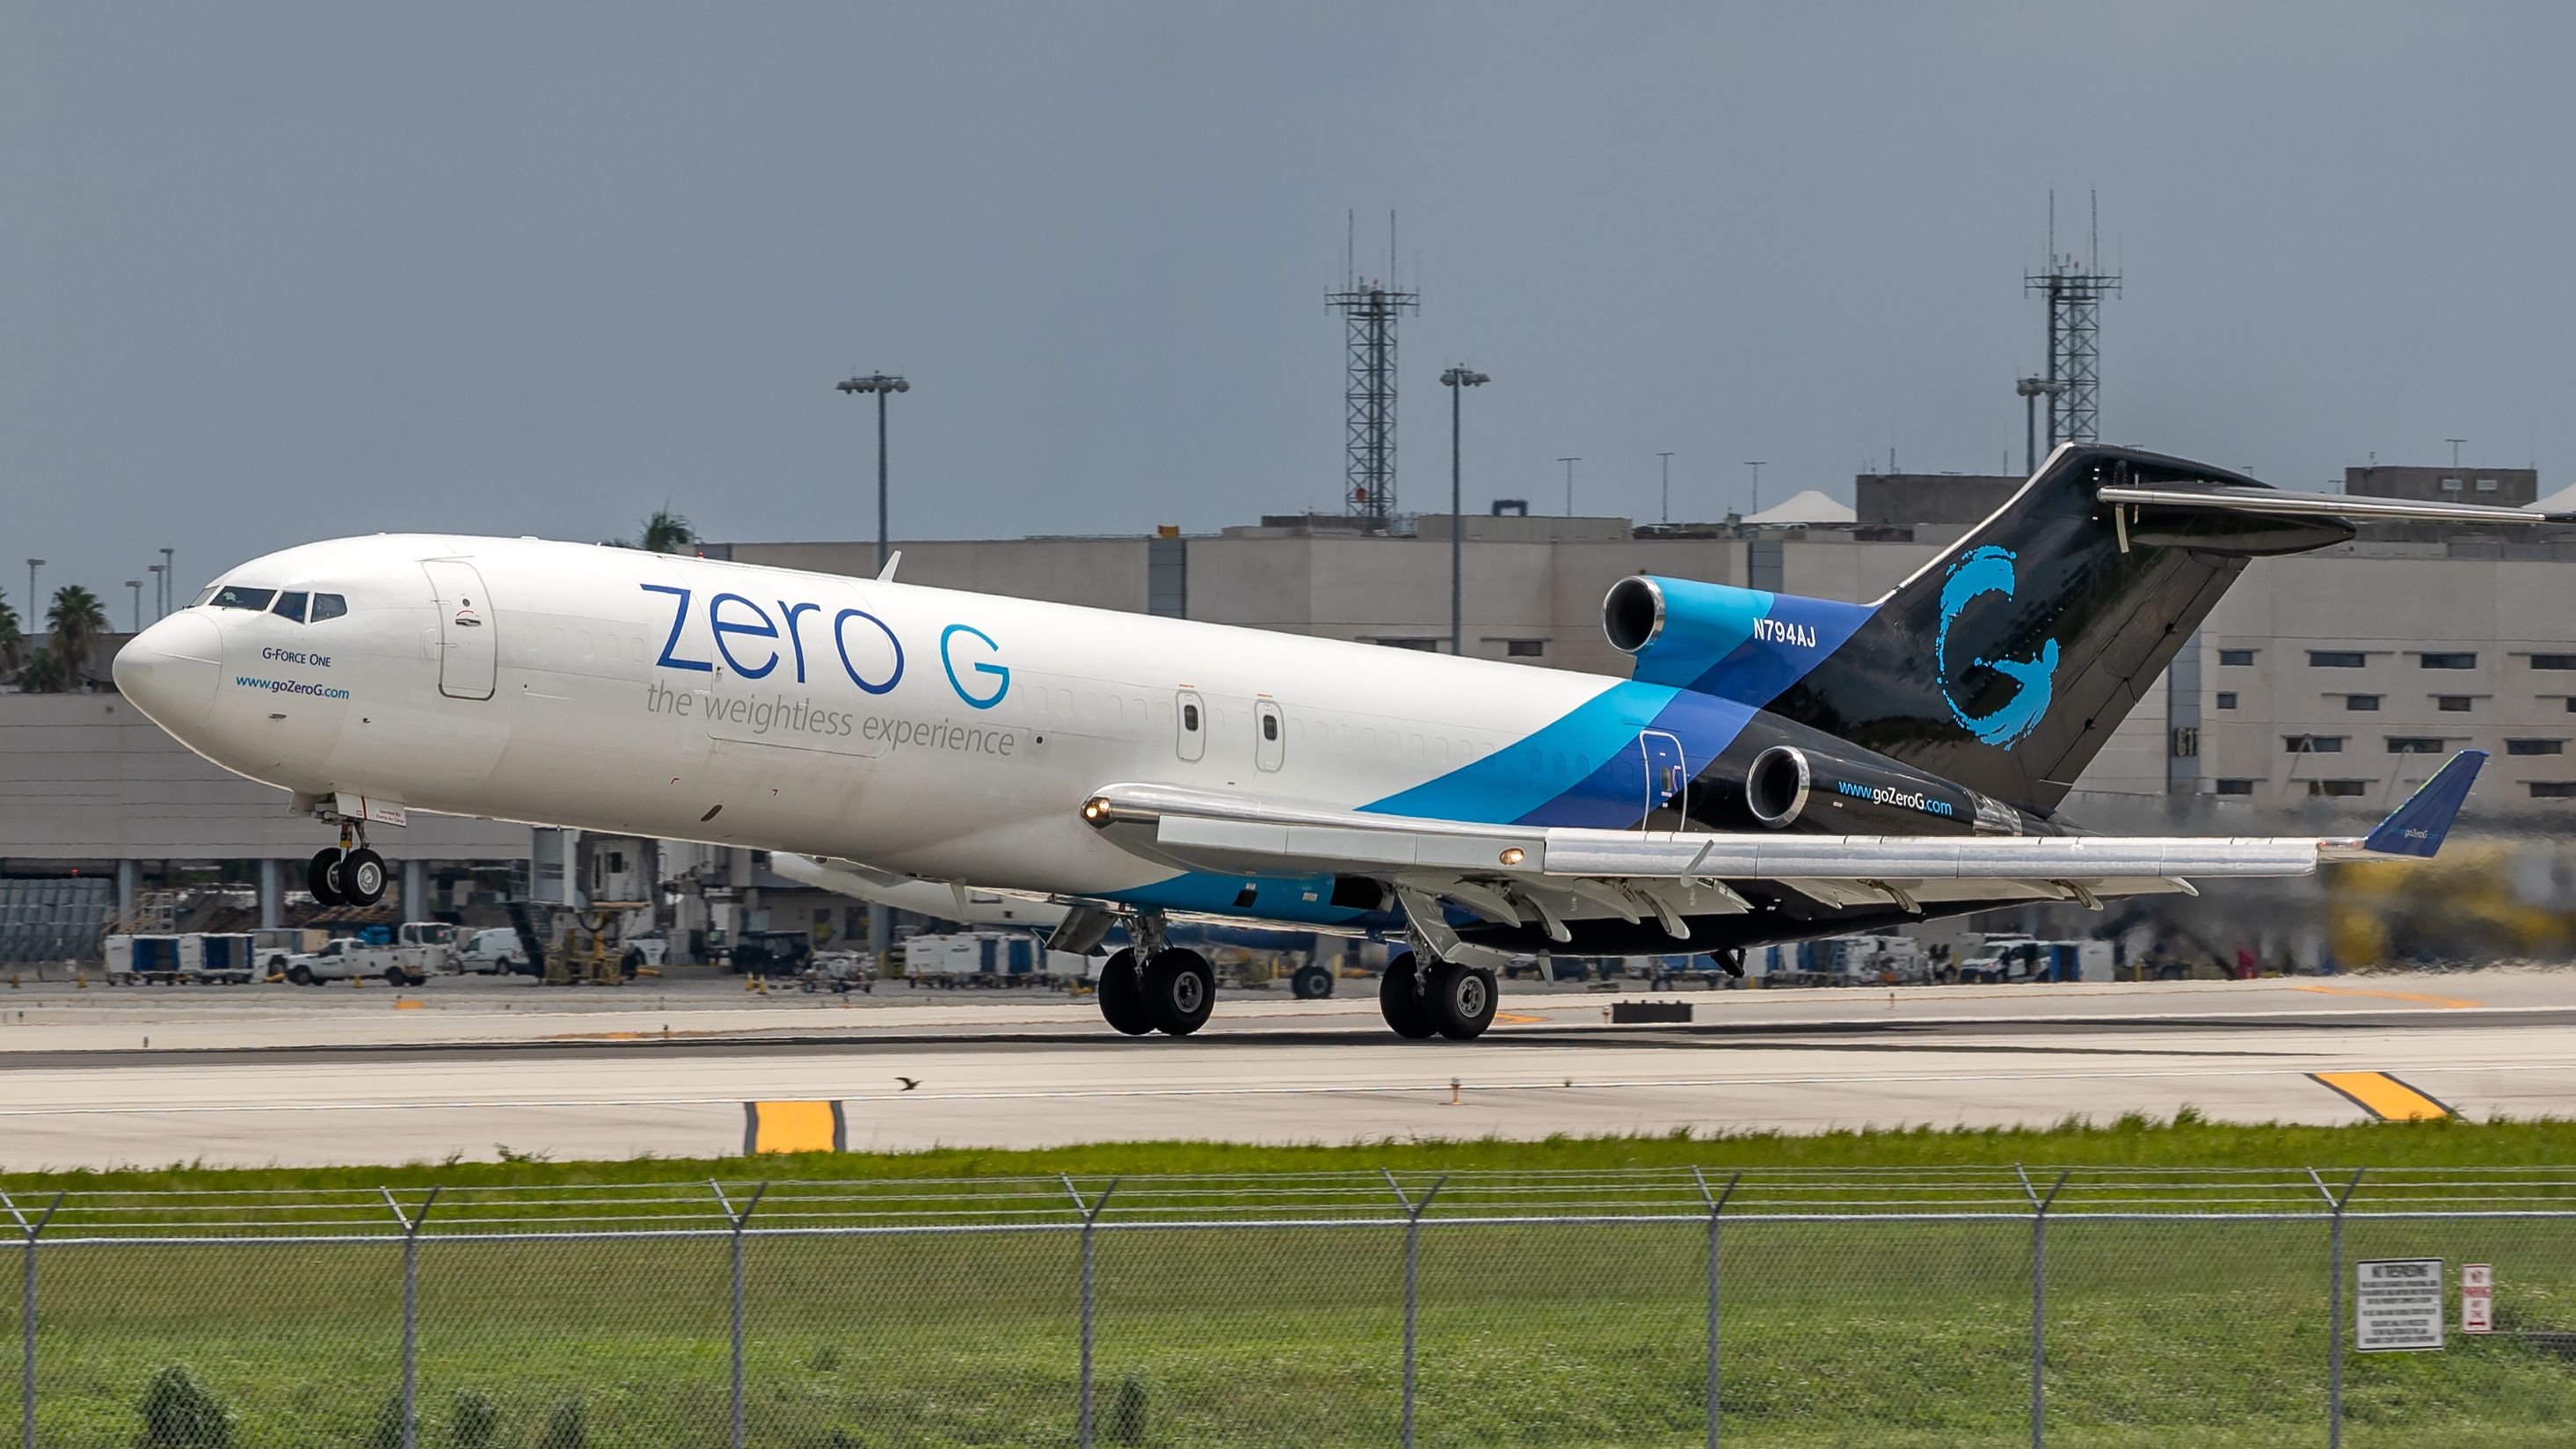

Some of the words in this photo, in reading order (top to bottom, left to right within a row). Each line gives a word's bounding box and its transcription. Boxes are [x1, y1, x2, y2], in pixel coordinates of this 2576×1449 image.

[1753, 617, 1816, 648] N794AJ
[940, 623, 1010, 710] G
[236, 675, 350, 700] www.goZeroG.com
[647, 680, 693, 717] the
[704, 691, 853, 737] weightless
[862, 716, 1015, 757] experience
[1838, 781, 1953, 816] www.goZeroG.com
